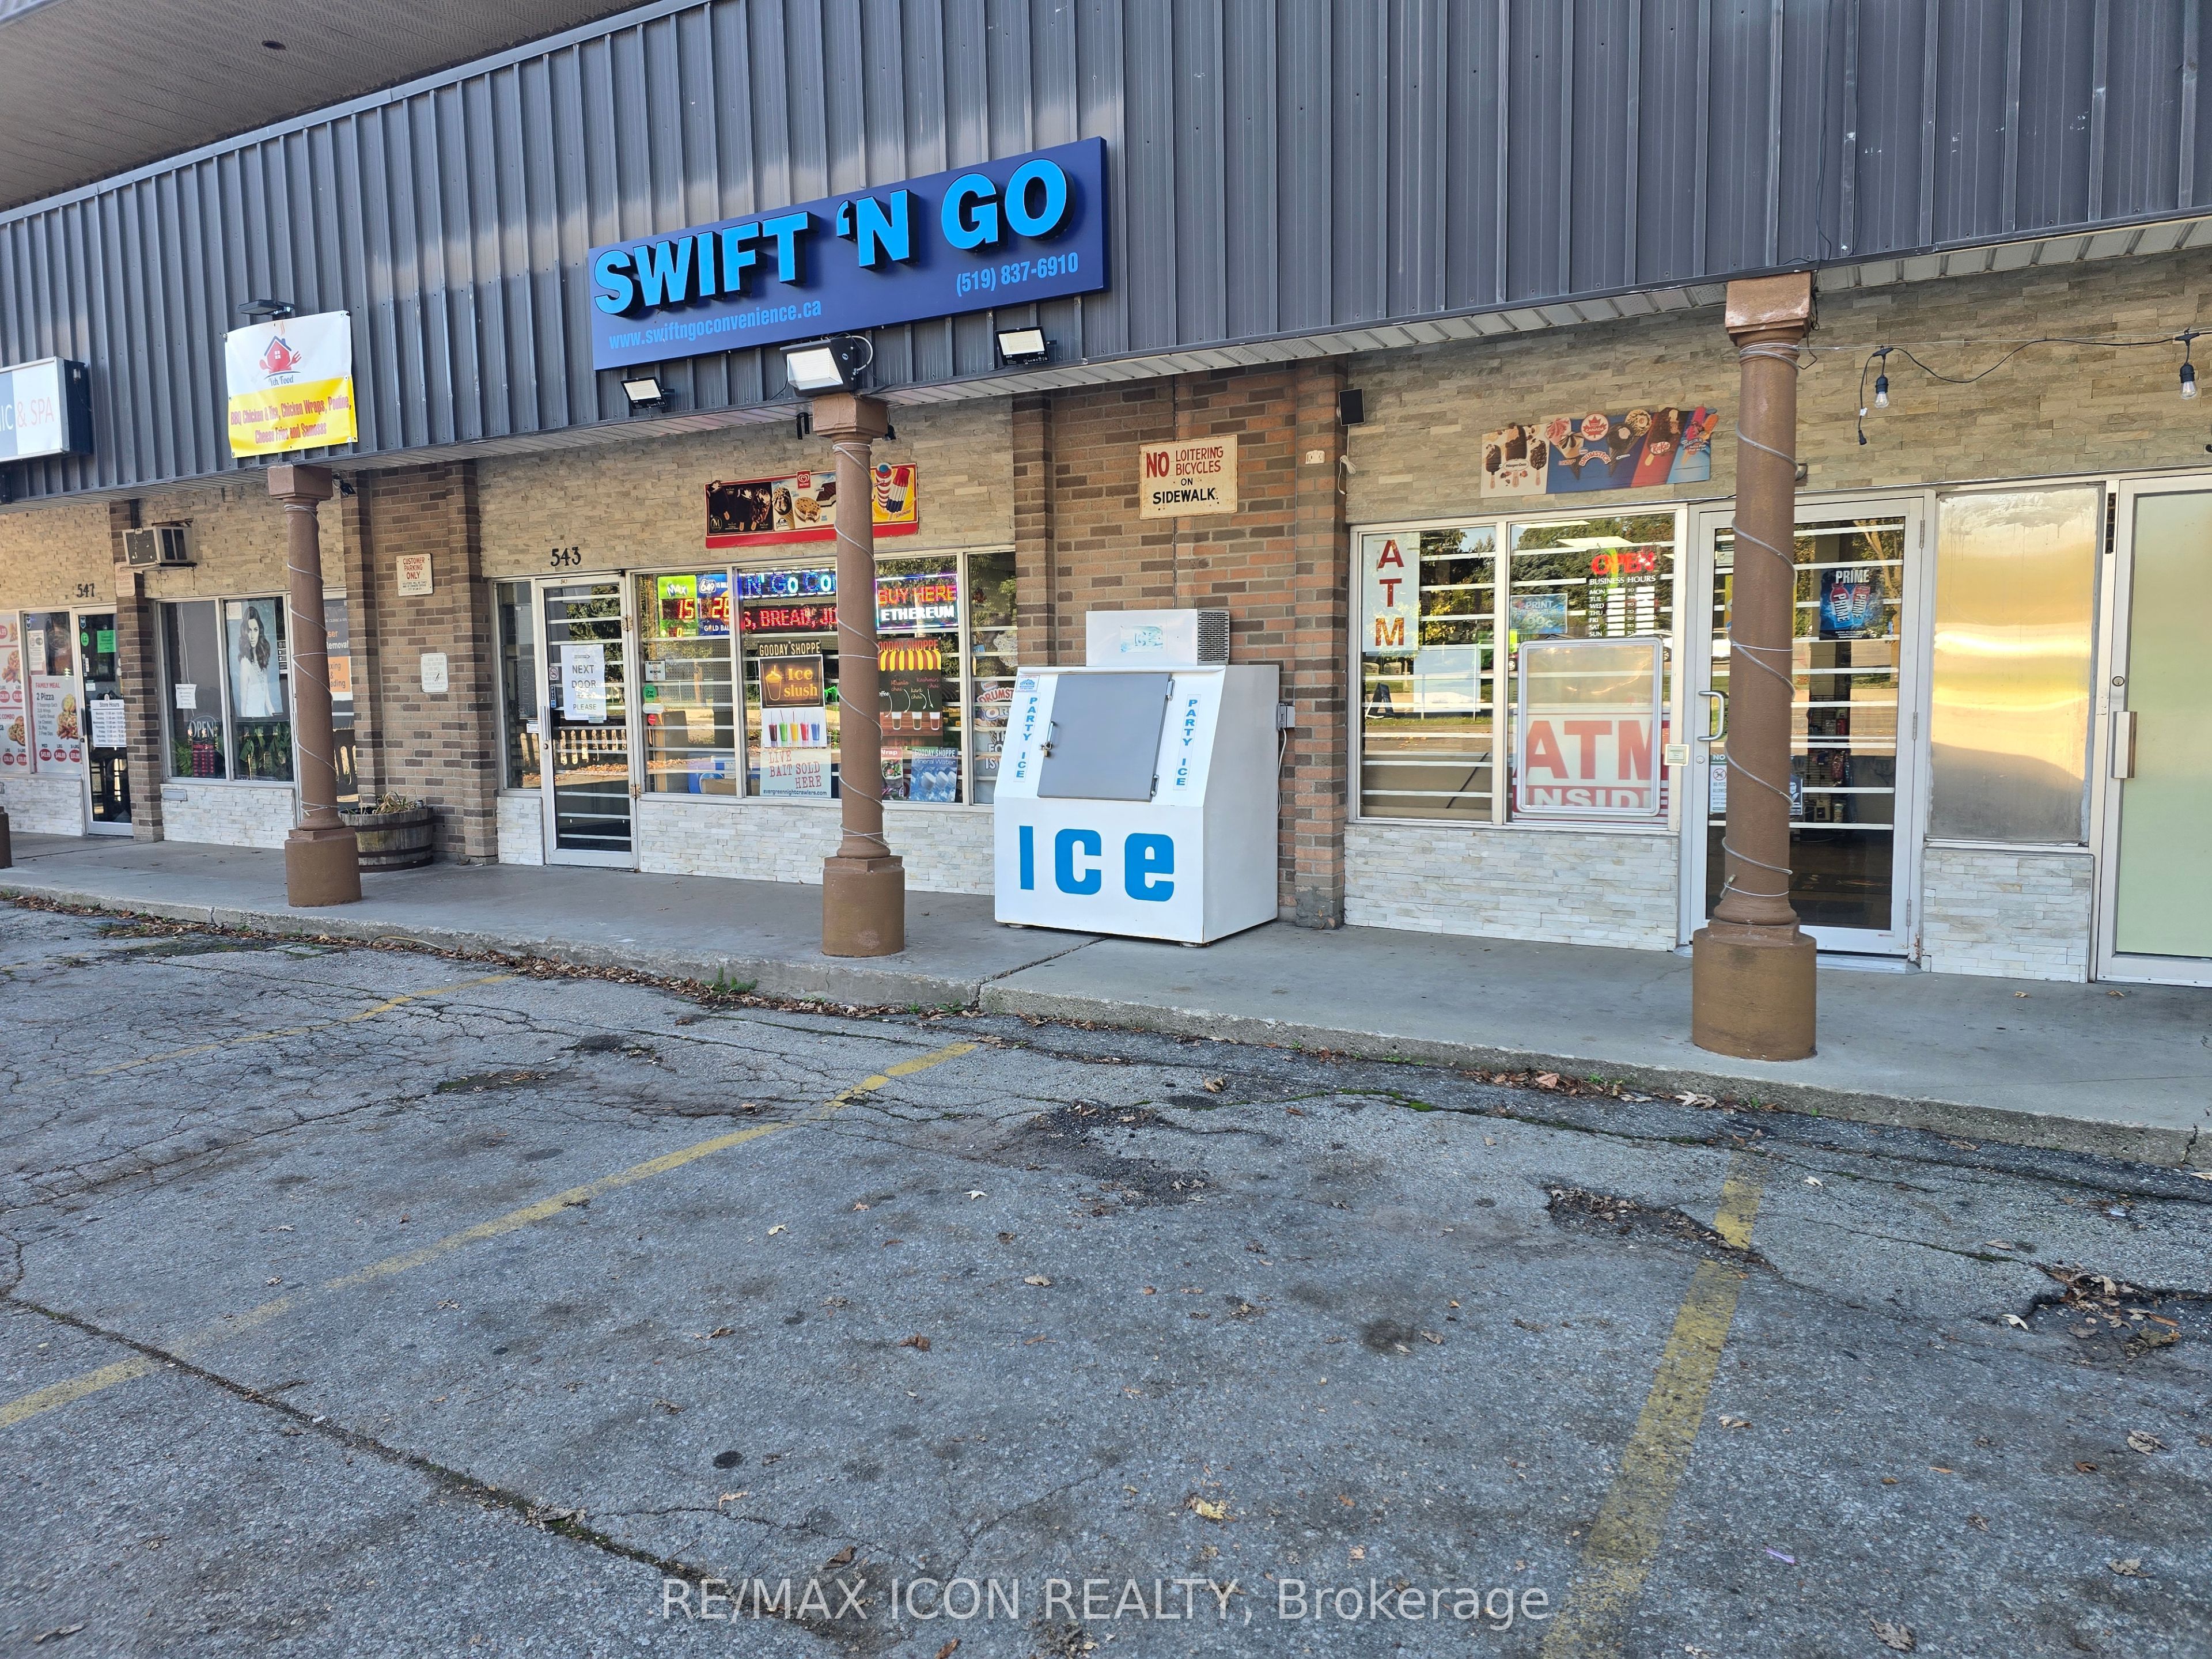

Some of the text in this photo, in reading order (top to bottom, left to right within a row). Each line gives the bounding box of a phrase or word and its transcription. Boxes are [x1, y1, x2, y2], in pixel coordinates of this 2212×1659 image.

[594, 211, 809, 315] SWIFT
[941, 158, 1069, 251] GO
[957, 252, 1078, 297] (519) 837-6910
[609, 300, 822, 350] www.swiftngoconvenience.ca
[281, 375, 294, 384] Food
[0, 397, 54, 432] IC & SPA
[231, 410, 242, 425] BBQ
[243, 410, 264, 424] Chicken
[281, 402, 303, 418] Chicken
[303, 400, 327, 415] Wraps,
[328, 395, 351, 410] Poutine,
[255, 423, 327, 444] Cheese Fries and Samosas
[1146, 446, 1224, 478] NO LOITERING
[1579, 450, 1611, 466] DRUMSTICK
[1176, 460, 1221, 476] BICYCLES
[550, 547, 581, 566] 543
[1591, 551, 1656, 575] OPEN
[406, 571, 421, 579] ONLY
[1589, 577, 1624, 585] BUSINESS
[1836, 569, 1870, 584] PRIME
[77, 583, 94, 597] 547
[667, 582, 687, 597] MAX
[700, 581, 714, 592] 649
[1376, 540, 1404, 646] ATM
[878, 585, 957, 605] BUY HERE
[679, 599, 695, 619] 15
[1525, 601, 1554, 609] PRINT
[1834, 593, 1850, 622] PRIME
[1852, 594, 1866, 619] PRIME
[760, 607, 816, 628] BREAD,
[881, 605, 955, 622] ETHEREUM
[676, 627, 683, 638] 0
[760, 642, 821, 656] GOODAY SHOPPE
[907, 639, 938, 651] SHOPPE
[572, 665, 594, 674] NEXT
[788, 668, 813, 681] Ice
[571, 680, 596, 688] DOOR
[784, 684, 817, 697] slush
[41, 692, 55, 700] Pizza
[189, 720, 214, 738] OPEN
[1016, 697, 1038, 778] PARTY ICE
[1176, 699, 1198, 786] PARTY ICE
[769, 749, 792, 763] LIVE
[935, 749, 955, 757] SHOPPE
[1525, 720, 1654, 781] ATM
[770, 761, 820, 777] BAIT SOLD
[985, 757, 996, 770] IS
[795, 775, 822, 789] HERE
[1526, 787, 1652, 808] NSID
